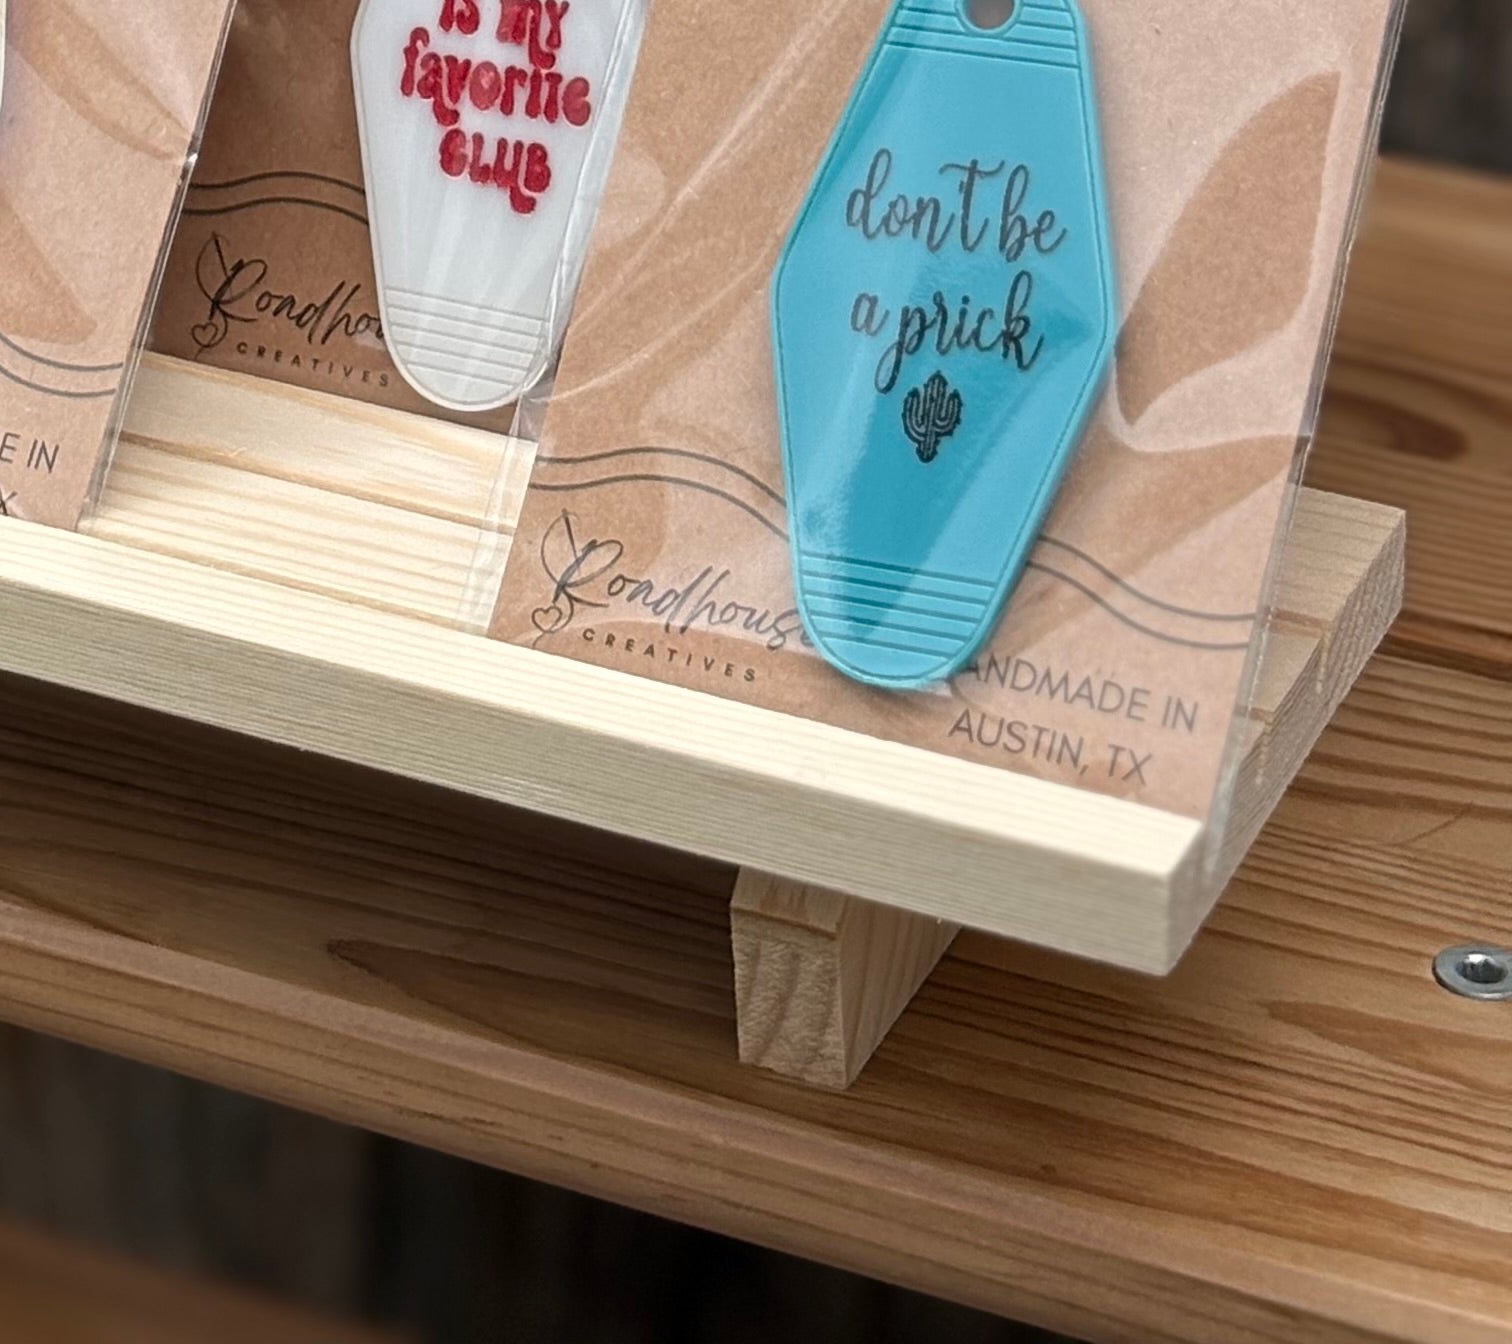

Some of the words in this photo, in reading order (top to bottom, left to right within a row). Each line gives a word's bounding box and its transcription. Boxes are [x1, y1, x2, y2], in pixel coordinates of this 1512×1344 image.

[846, 148, 1005, 255] don't
[998, 163, 1068, 263] be
[850, 292, 891, 337] a
[875, 269, 1045, 395] prick
[236, 341, 389, 387] CREATIVES
[26, 438, 60, 474] IN
[582, 627, 758, 683] CREATIVES
[1161, 694, 1200, 733] IN
[947, 708, 1090, 777] AUSTIN,
[1106, 744, 1154, 788] TX
